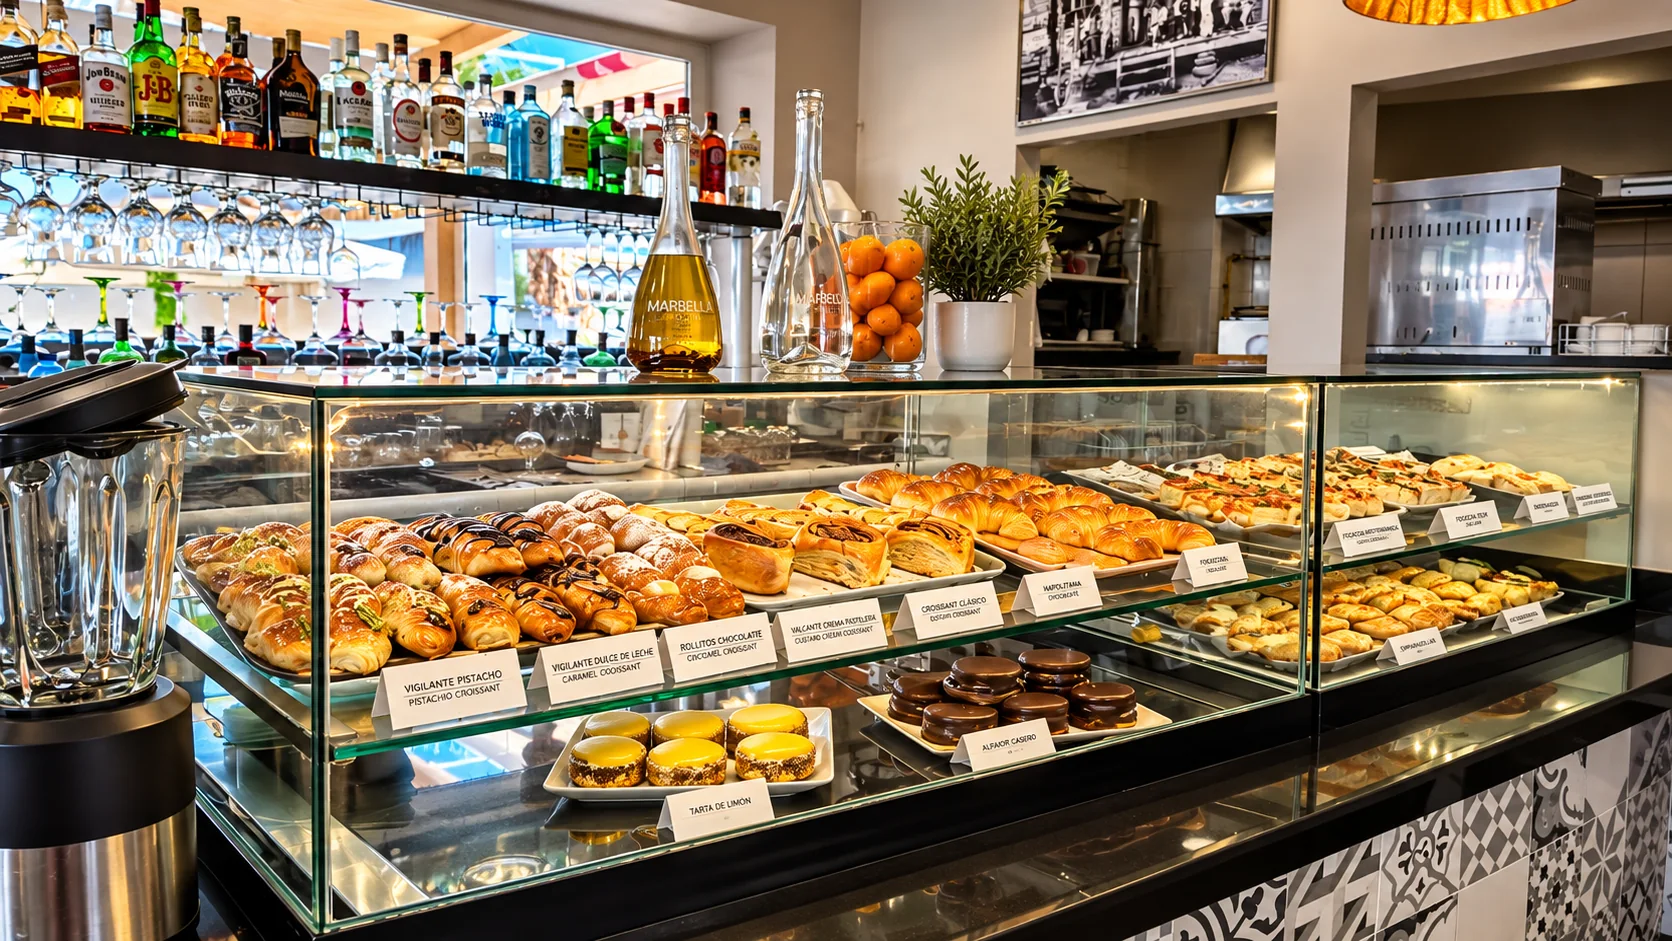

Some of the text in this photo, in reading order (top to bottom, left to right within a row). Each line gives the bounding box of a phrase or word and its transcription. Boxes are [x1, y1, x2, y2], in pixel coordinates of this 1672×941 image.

[647, 300, 714, 313] MARBELLA
[680, 638, 717, 652] ROLLITOS
[551, 647, 654, 672] VIGILANTE DULCE DE LECHE
[404, 669, 503, 693] VIGILANTE PISTACHO
[562, 670, 598, 684] CARAMEL
[408, 683, 501, 707] PISTACHIO CROISSANT
[689, 797, 752, 816] TARTA DE LIMÓN
